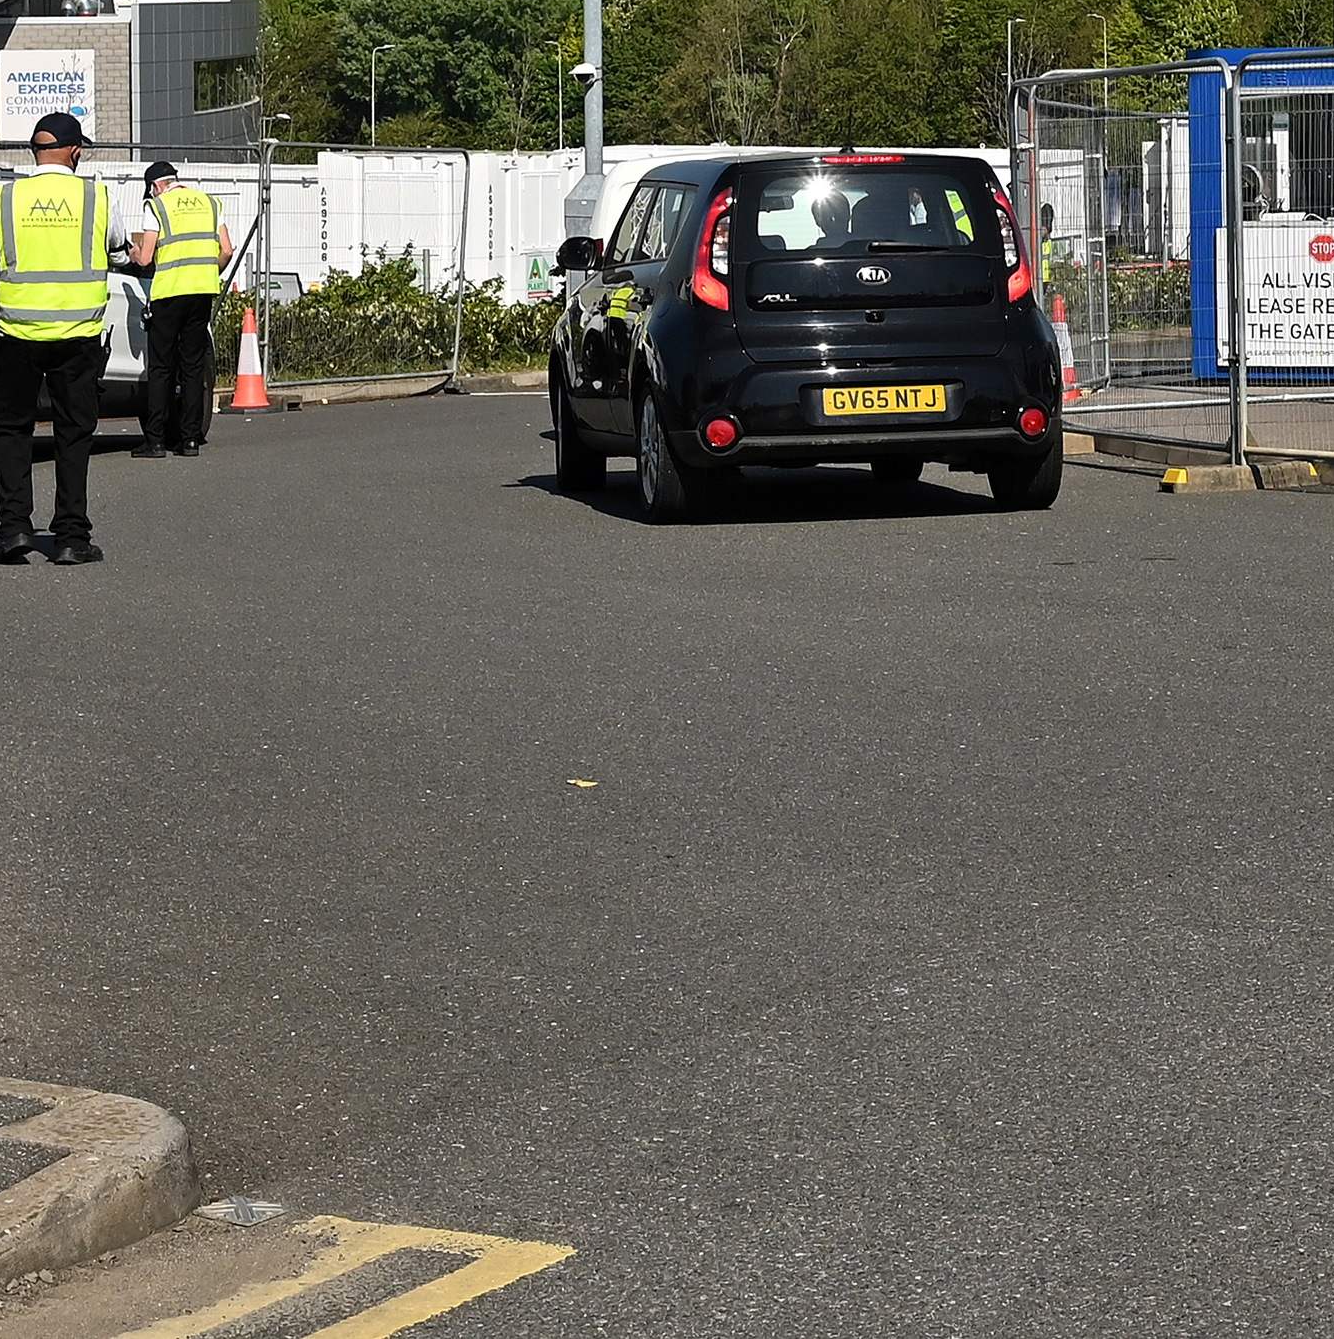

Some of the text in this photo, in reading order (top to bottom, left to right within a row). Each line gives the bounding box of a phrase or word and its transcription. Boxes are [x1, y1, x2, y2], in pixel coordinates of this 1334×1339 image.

[7, 72, 84, 83] AMERICAN
[18, 84, 85, 94] EXPRESS
[6, 96, 85, 105] COMMUNITY
[861, 267, 886, 281] KIA
[1262, 273, 1297, 289] ALL
[1247, 298, 1305, 314] LEASE
[1248, 323, 1284, 340] THE
[833, 388, 938, 411] GV65 NTJ
